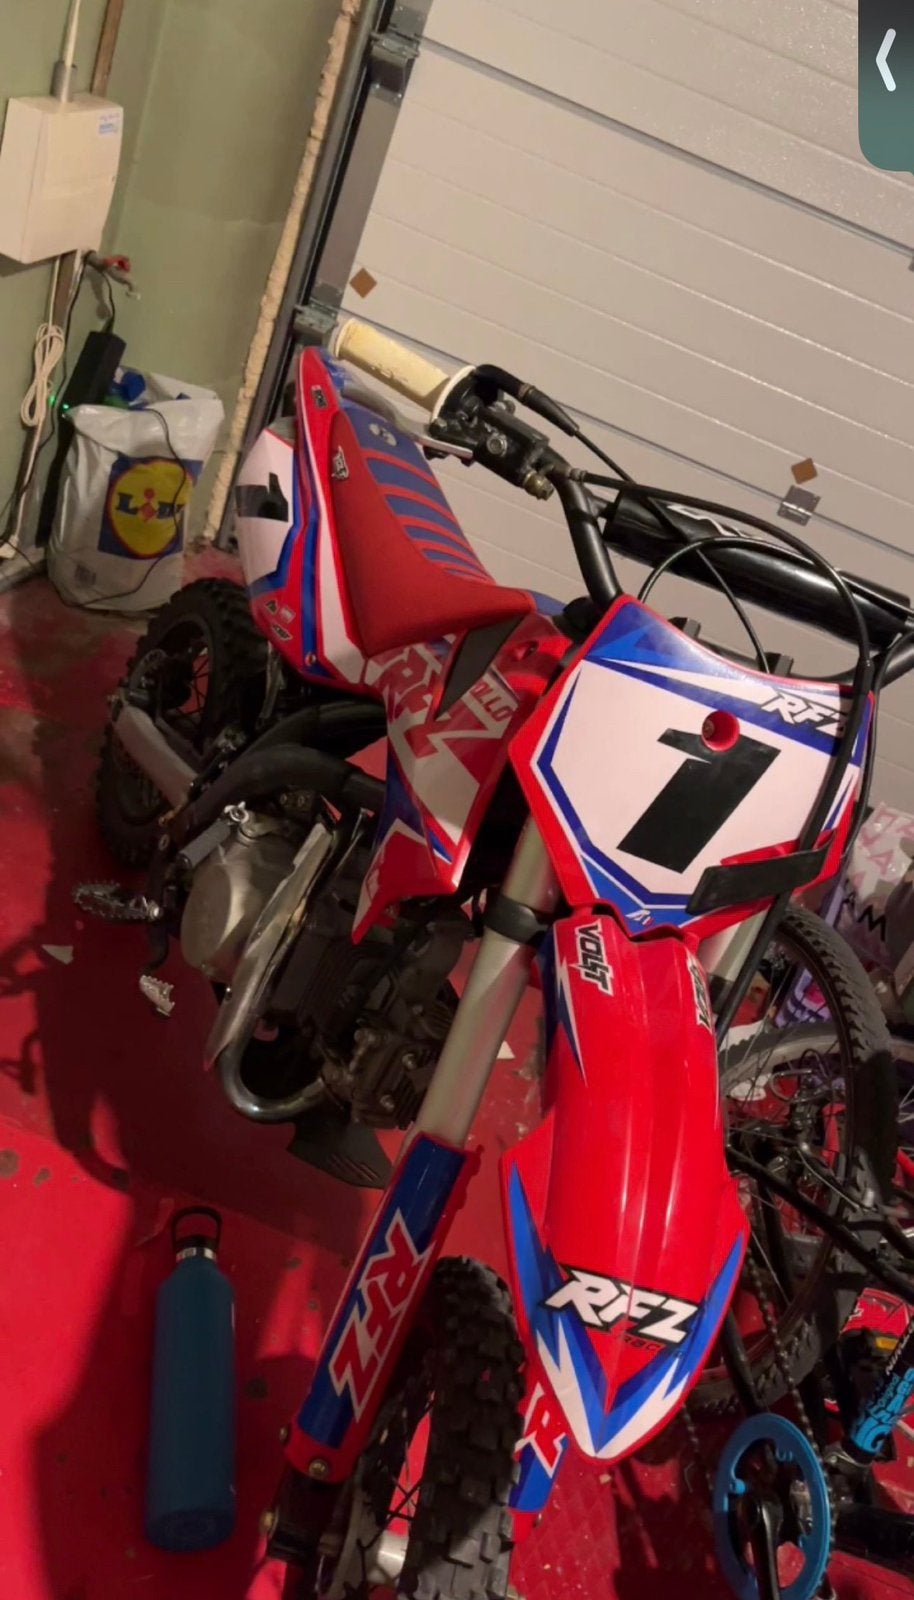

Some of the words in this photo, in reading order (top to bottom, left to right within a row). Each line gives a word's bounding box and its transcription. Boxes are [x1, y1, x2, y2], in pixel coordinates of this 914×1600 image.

[468, 679, 515, 723] OLLO
[616, 727, 782, 874] 1
[572, 919, 614, 995] VOLT
[331, 1211, 430, 1417] RFZ
[541, 1266, 701, 1345] RFZ
